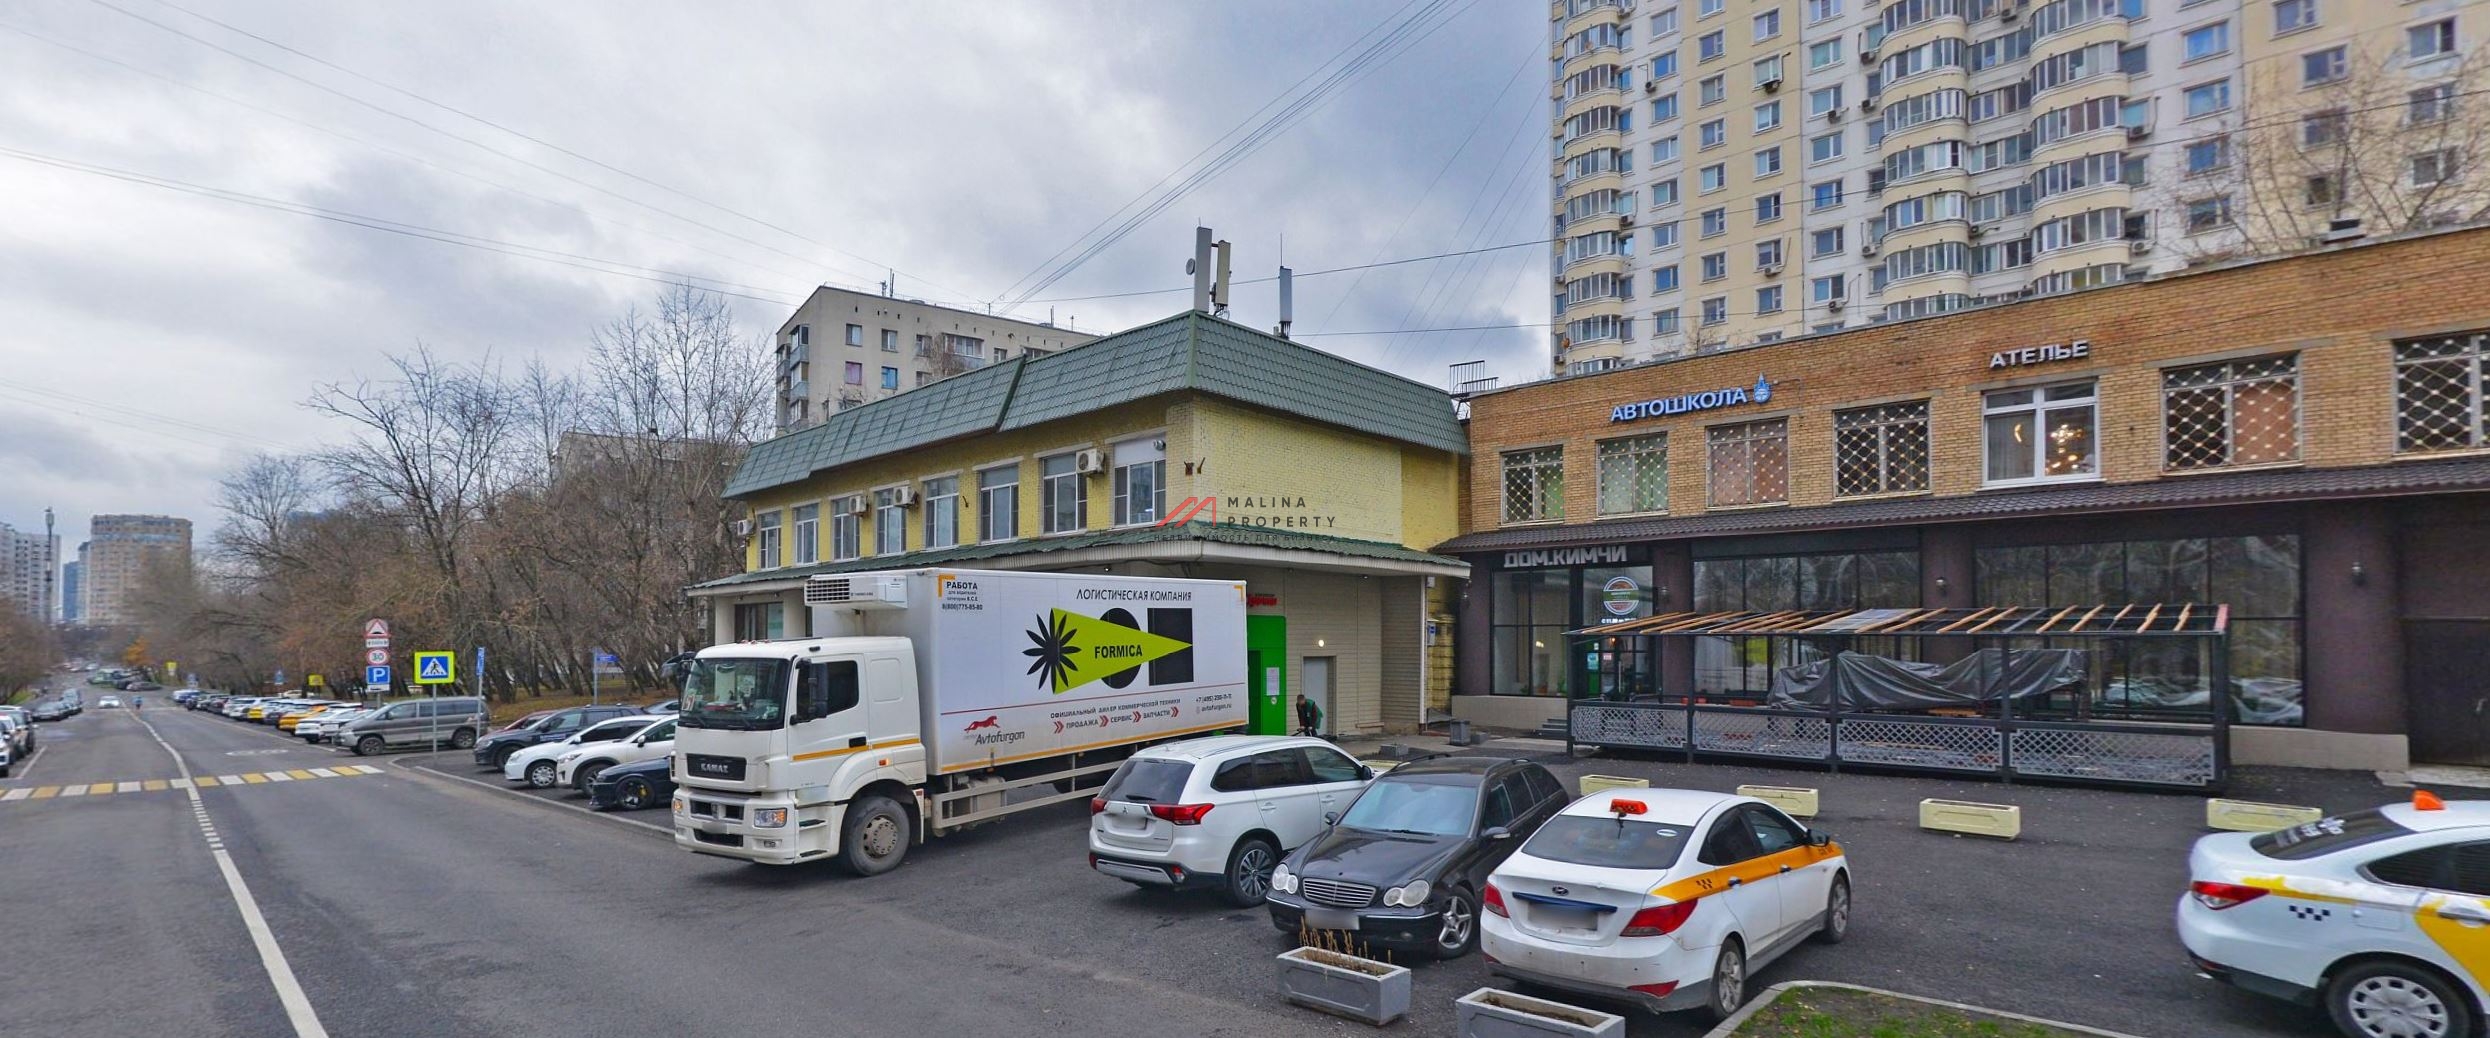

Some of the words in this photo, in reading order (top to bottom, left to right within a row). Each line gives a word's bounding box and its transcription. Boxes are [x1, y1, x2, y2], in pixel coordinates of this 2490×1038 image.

[1989, 340, 2089, 368] АТЕЛЬЕ
[1610, 387, 1748, 422] АВТОШКОЛА
[1503, 545, 1627, 568] ДОМ.КИМЧИ
[946, 581, 978, 590] РАБОТА
[1076, 588, 1148, 601] ЛОГИСТИЧЕСКАЯ
[1149, 590, 1192, 601] КОМПАНИЯ
[1094, 644, 1143, 659] FORMICA
[373, 668, 386, 682] P
[1050, 708, 1097, 719] ОФИЦИАЛЬНЫЙ
[1098, 705, 1117, 714] ДИЛЕР
[1117, 700, 1159, 711] КОММЕРЧЕСКОЙ
[1159, 698, 1181, 706] ТЕХНИКИ
[1066, 719, 1099, 729] ПРОДАЖА
[1110, 714, 1132, 724] СЕРВИС
[1143, 710, 1171, 719] ЗАПЧАСТИ
[974, 731, 1025, 746] Avtofurgon
[700, 763, 729, 773] KAMAZ
